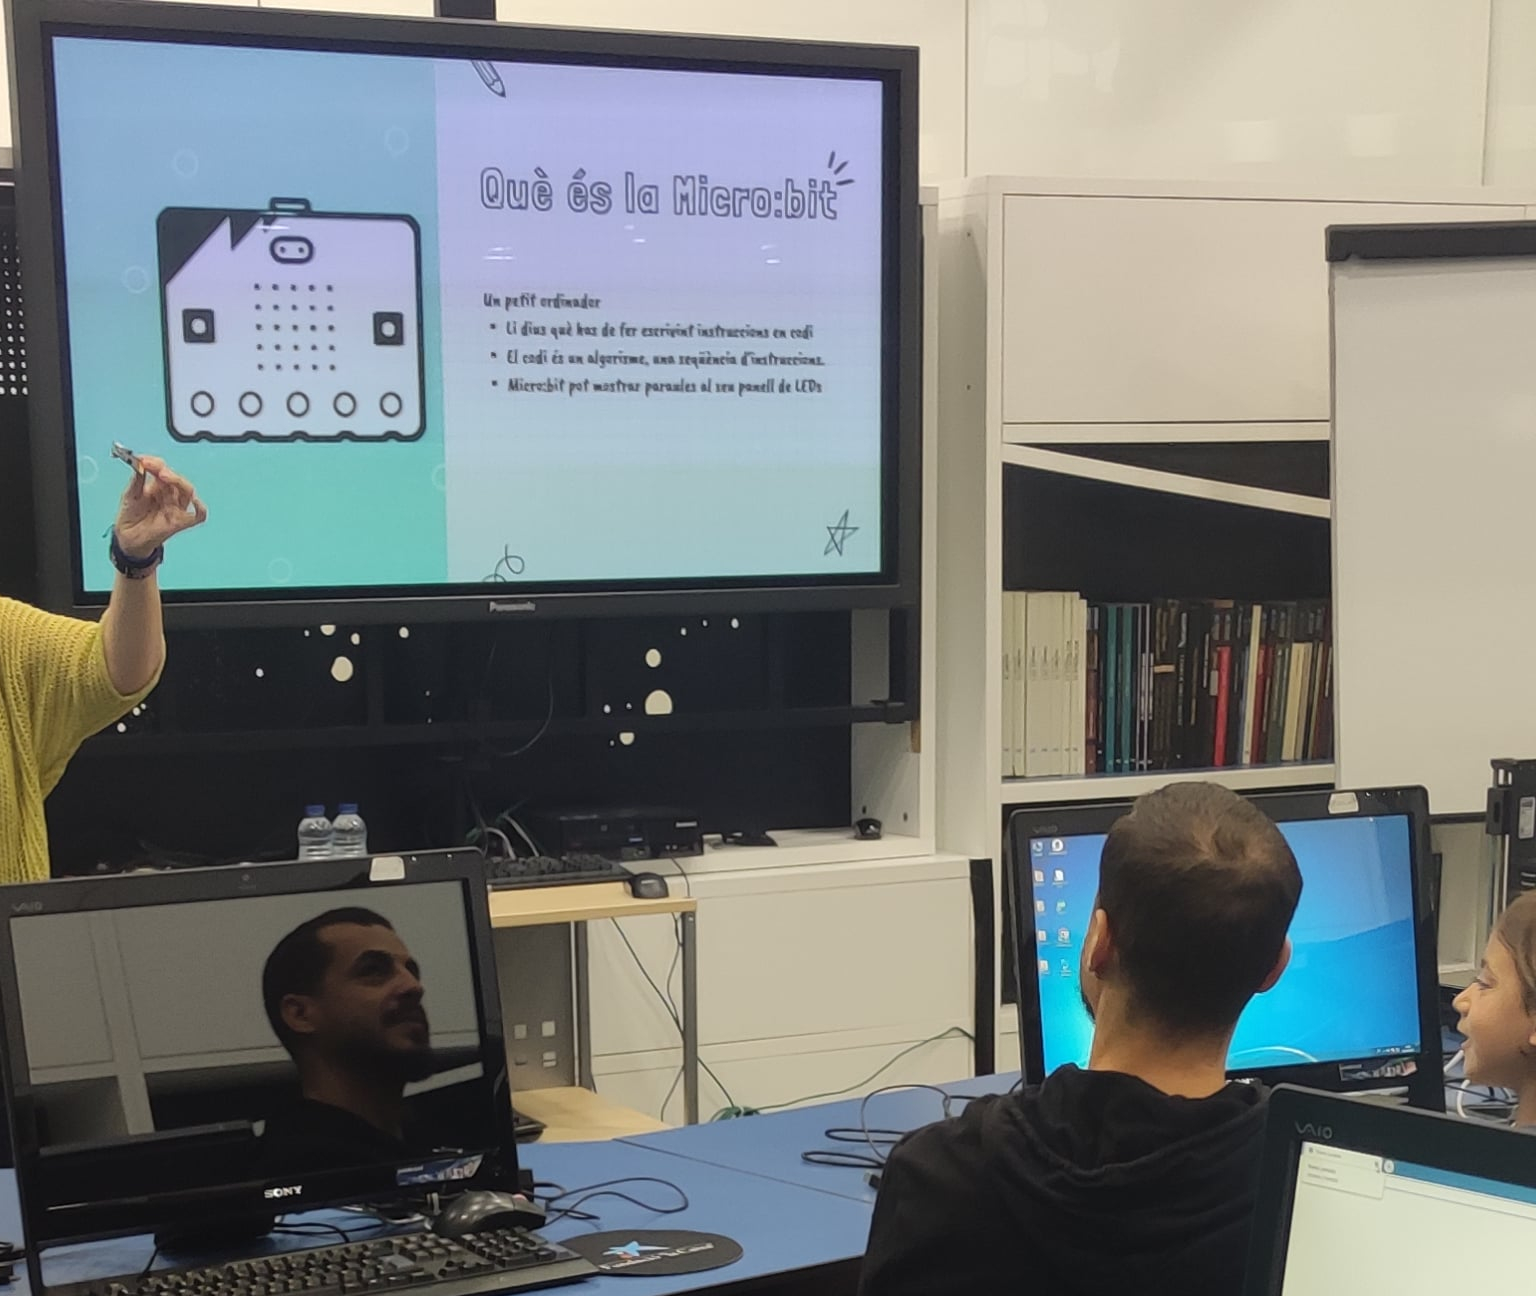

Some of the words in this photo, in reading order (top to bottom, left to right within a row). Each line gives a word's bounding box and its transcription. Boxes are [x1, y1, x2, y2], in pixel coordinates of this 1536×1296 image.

[480, 166, 553, 210] Què
[567, 167, 612, 215] és
[624, 171, 660, 214] la
[673, 174, 838, 220] Micro:bit
[483, 293, 501, 308] Un
[505, 293, 536, 311] petit
[540, 293, 601, 309] ordinador
[506, 321, 517, 336] Li
[521, 321, 546, 336] dius
[550, 321, 573, 340] què
[576, 322, 598, 337] has
[601, 322, 615, 337] de
[619, 322, 637, 338] fer
[641, 323, 694, 338] escrivint
[697, 323, 769, 339] instruccions
[773, 328, 787, 339] en
[790, 325, 813, 340] codi
[507, 349, 518, 365] El
[522, 349, 547, 365] codi
[551, 350, 564, 365] és
[568, 354, 583, 365] un
[587, 349, 649, 369] algorisme,
[653, 354, 675, 366] una
[507, 377, 564, 393] Micro:bit
[568, 379, 590, 397] pot
[593, 379, 640, 393] mostrar
[644, 378, 697, 398] paraules
[700, 378, 712, 393] al
[715, 381, 735, 393] seu
[738, 378, 775, 398] panell
[778, 379, 792, 394] de
[795, 379, 822, 394] LEDs
[1295, 1121, 1333, 1140] VAIO
[264, 1184, 303, 1199] SONY
